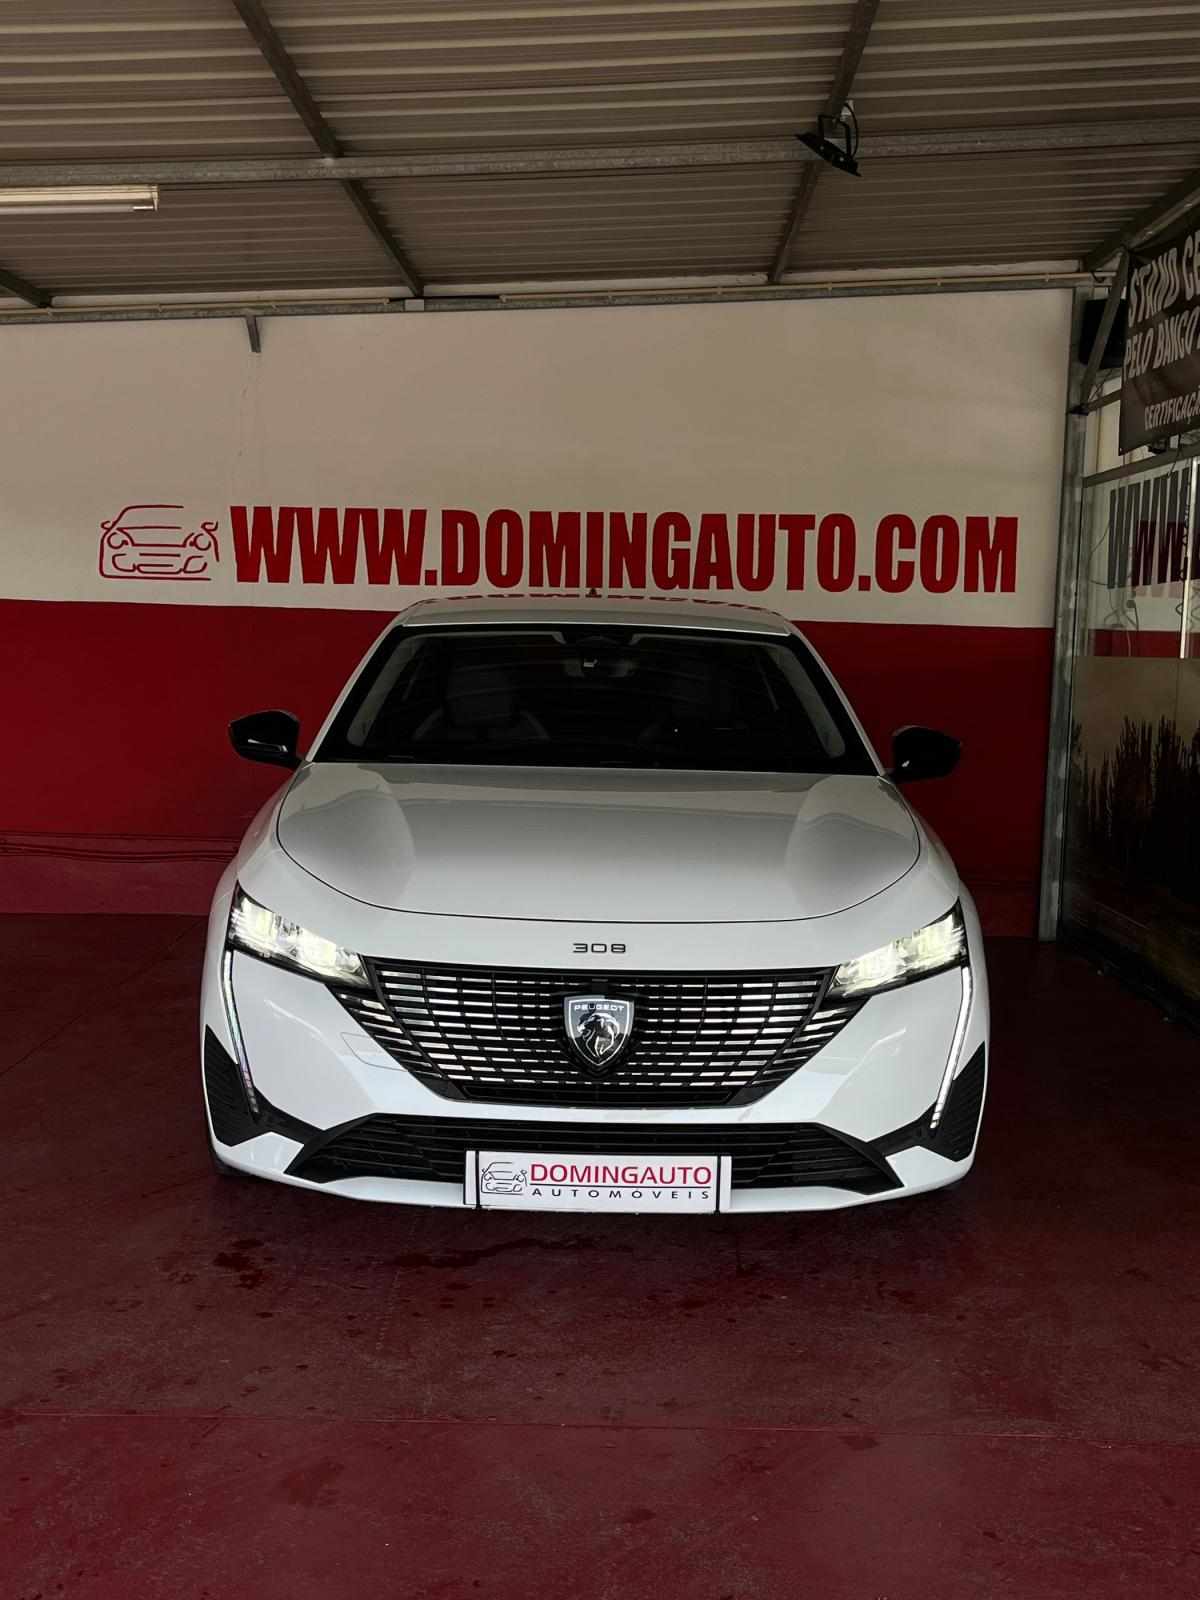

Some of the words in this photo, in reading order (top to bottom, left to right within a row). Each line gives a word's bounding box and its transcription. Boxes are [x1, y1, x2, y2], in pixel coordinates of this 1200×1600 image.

[1128, 247, 1179, 328] STAND
[1123, 327, 1154, 383] PELO
[1152, 306, 1200, 369] BANCO
[229, 505, 1018, 594] WWW.DOMINGAUTO.COM
[573, 943, 626, 953] 308
[574, 1003, 625, 1011] PEUGEOT
[530, 1163, 712, 1185] DOMINGAUTO
